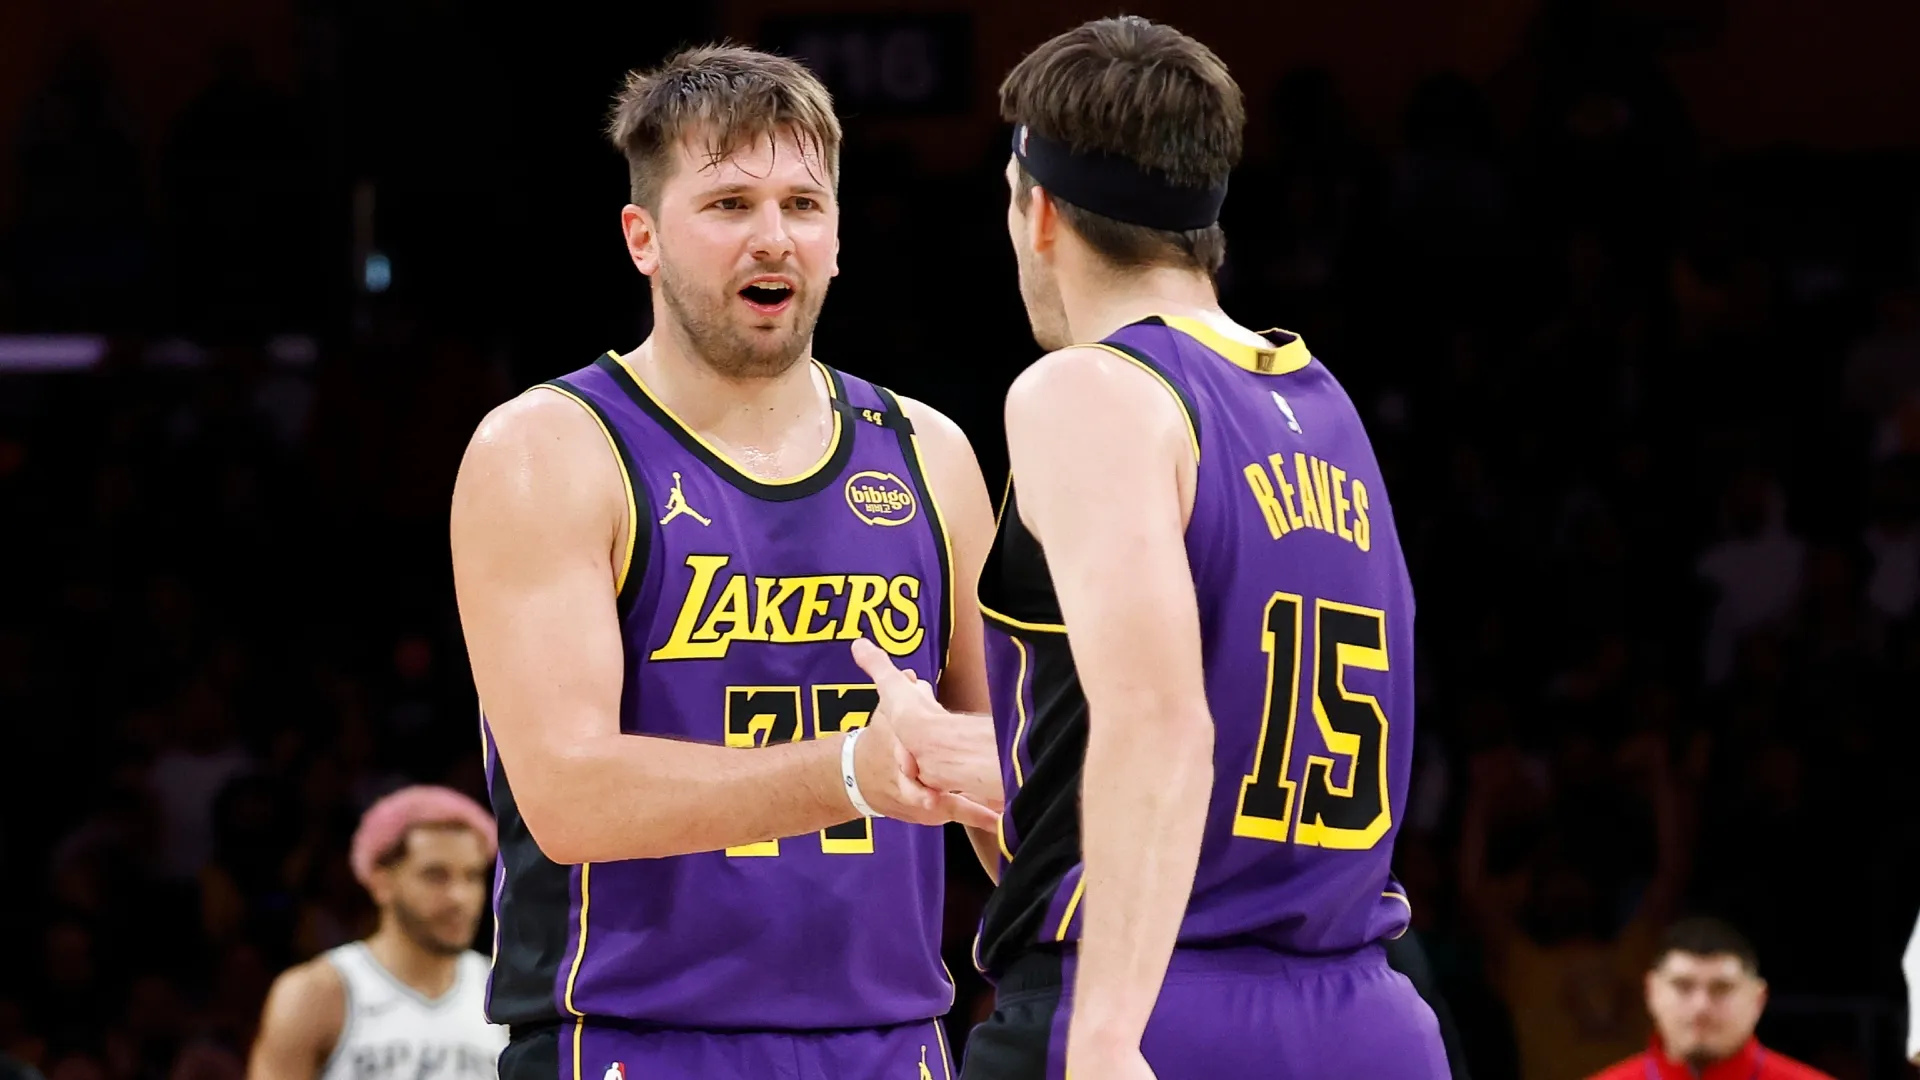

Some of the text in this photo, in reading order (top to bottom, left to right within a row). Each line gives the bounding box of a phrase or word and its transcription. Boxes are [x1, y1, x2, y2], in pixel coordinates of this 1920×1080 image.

[850, 485, 911, 510] bibigo
[1242, 452, 1371, 553] REAVES
[1231, 591, 1393, 851] 15
